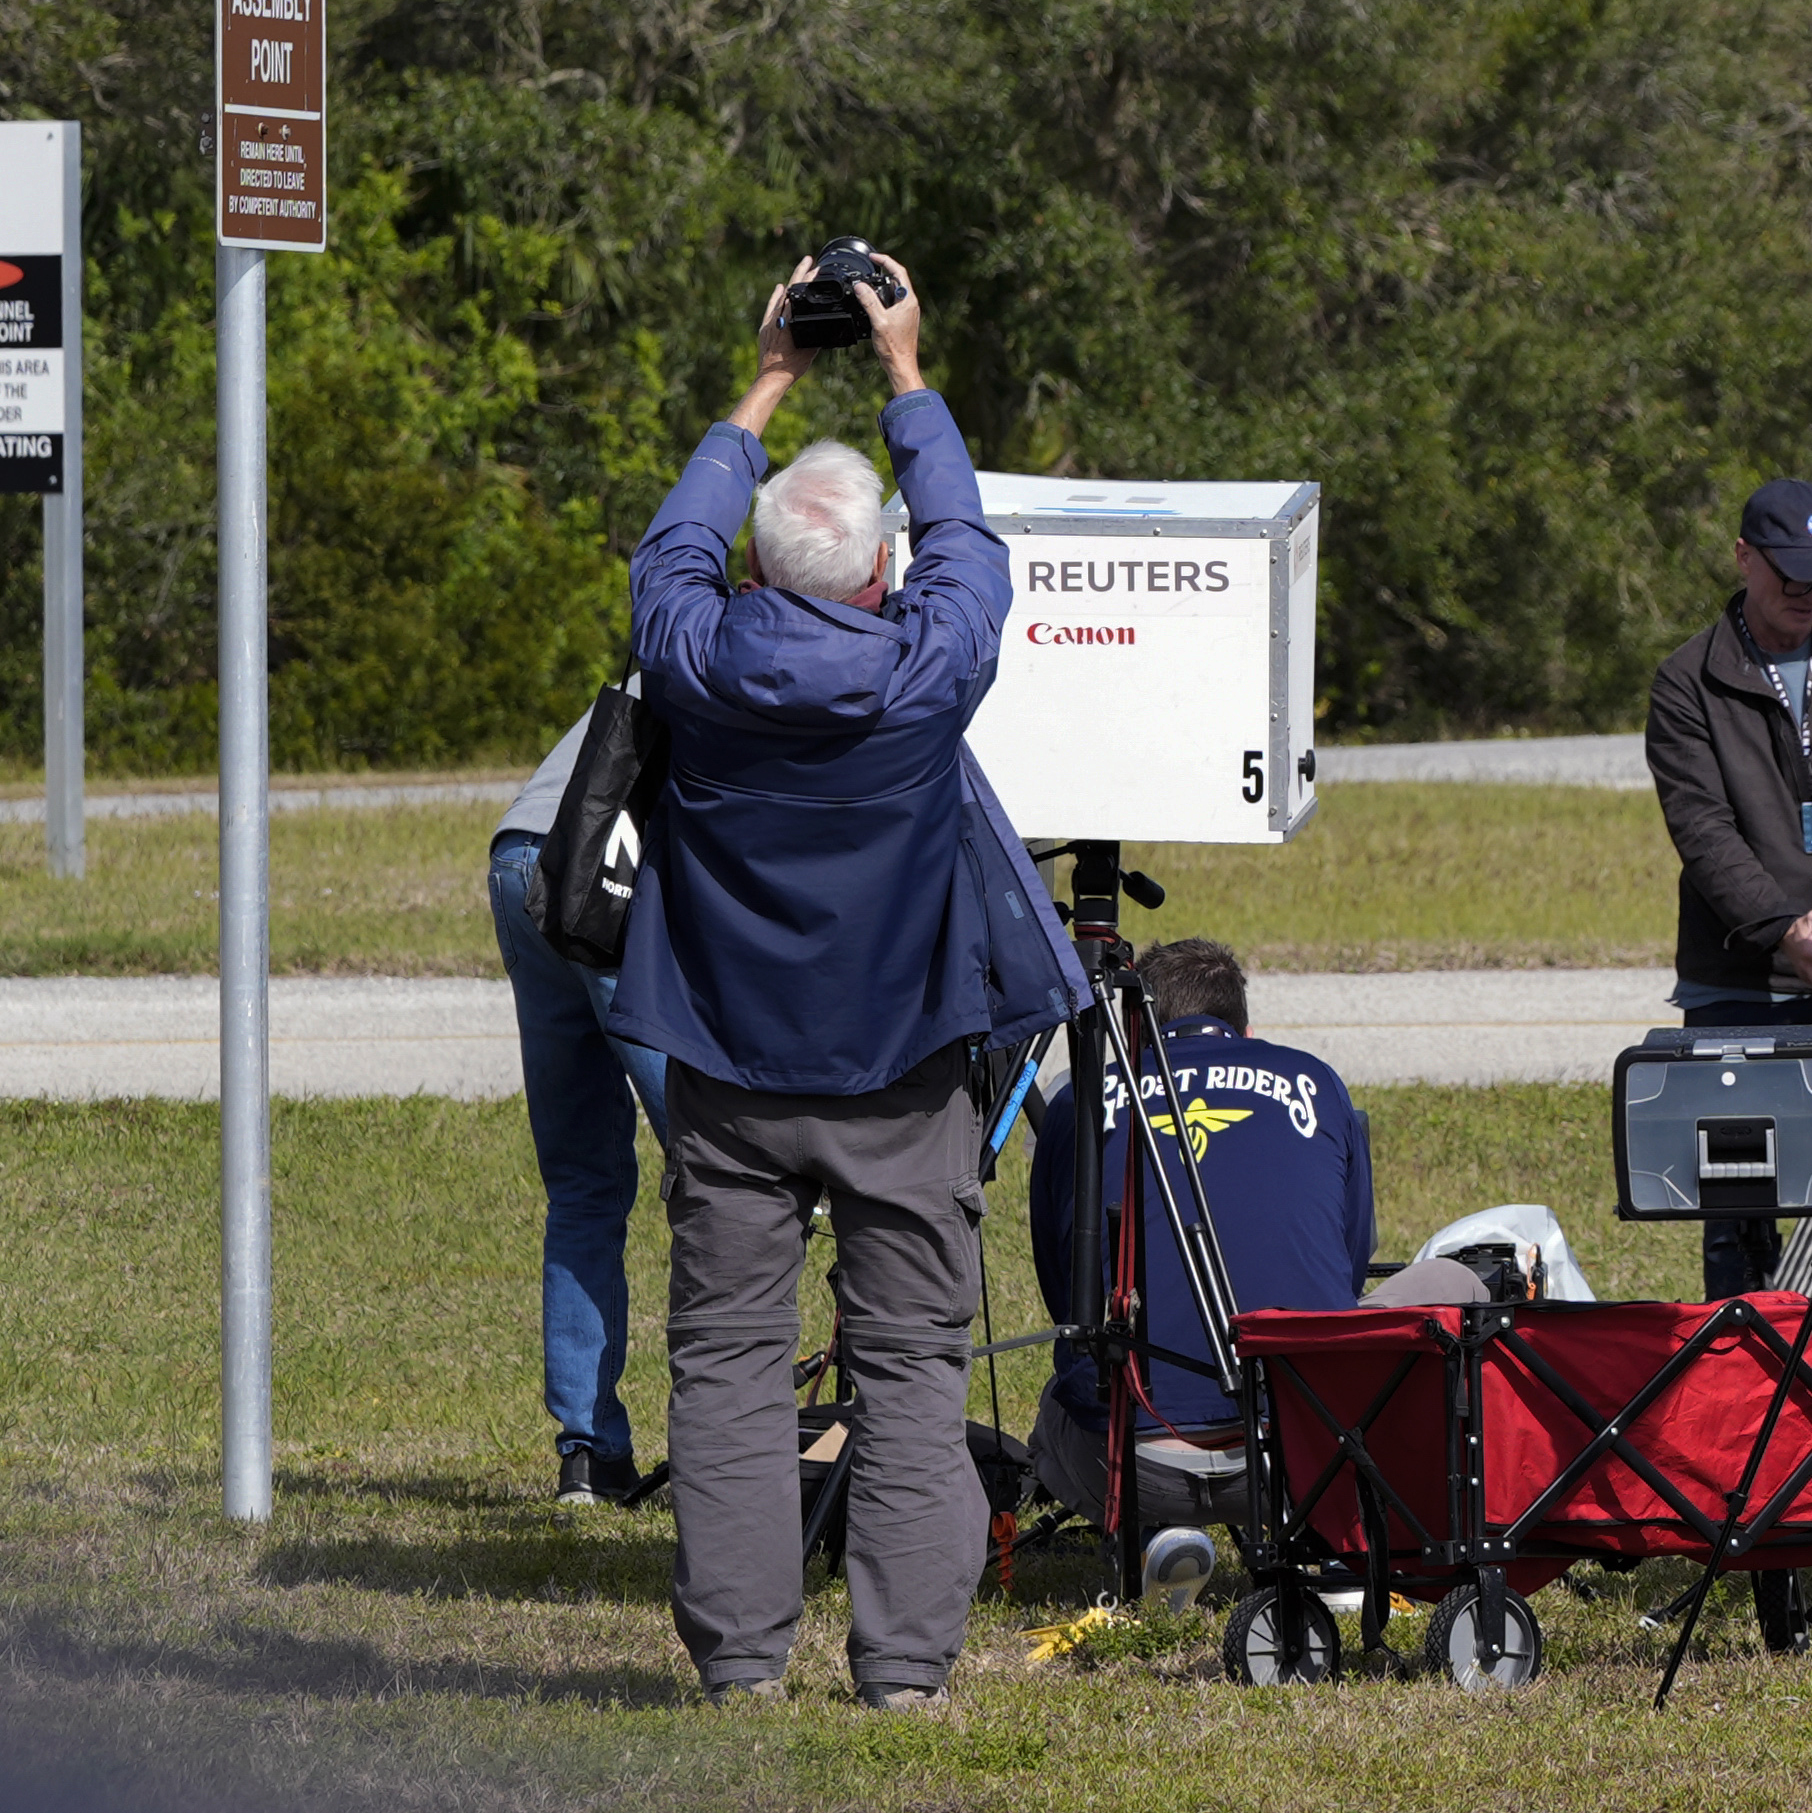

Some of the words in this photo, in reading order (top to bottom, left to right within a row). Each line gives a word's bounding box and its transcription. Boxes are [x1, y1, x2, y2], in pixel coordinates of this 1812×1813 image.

[251, 39, 293, 84] POINT
[240, 140, 266, 161] REMAIN
[266, 142, 285, 162] HERE
[284, 145, 305, 164] UNTIL
[240, 168, 273, 188] DIRECTED
[273, 170, 283, 189] TO
[283, 171, 305, 191] LEAVE
[228, 194, 239, 214] BY
[239, 195, 279, 217] COMPETENT
[279, 198, 317, 220] AUTHORITY
[15, 359, 50, 376] AREA
[4, 382, 28, 400] THE
[1028, 560, 1230, 593] REUTERS
[1027, 622, 1136, 646] Canon
[1242, 750, 1264, 804] 5
[1205, 1066, 1318, 1139] RIDERS
